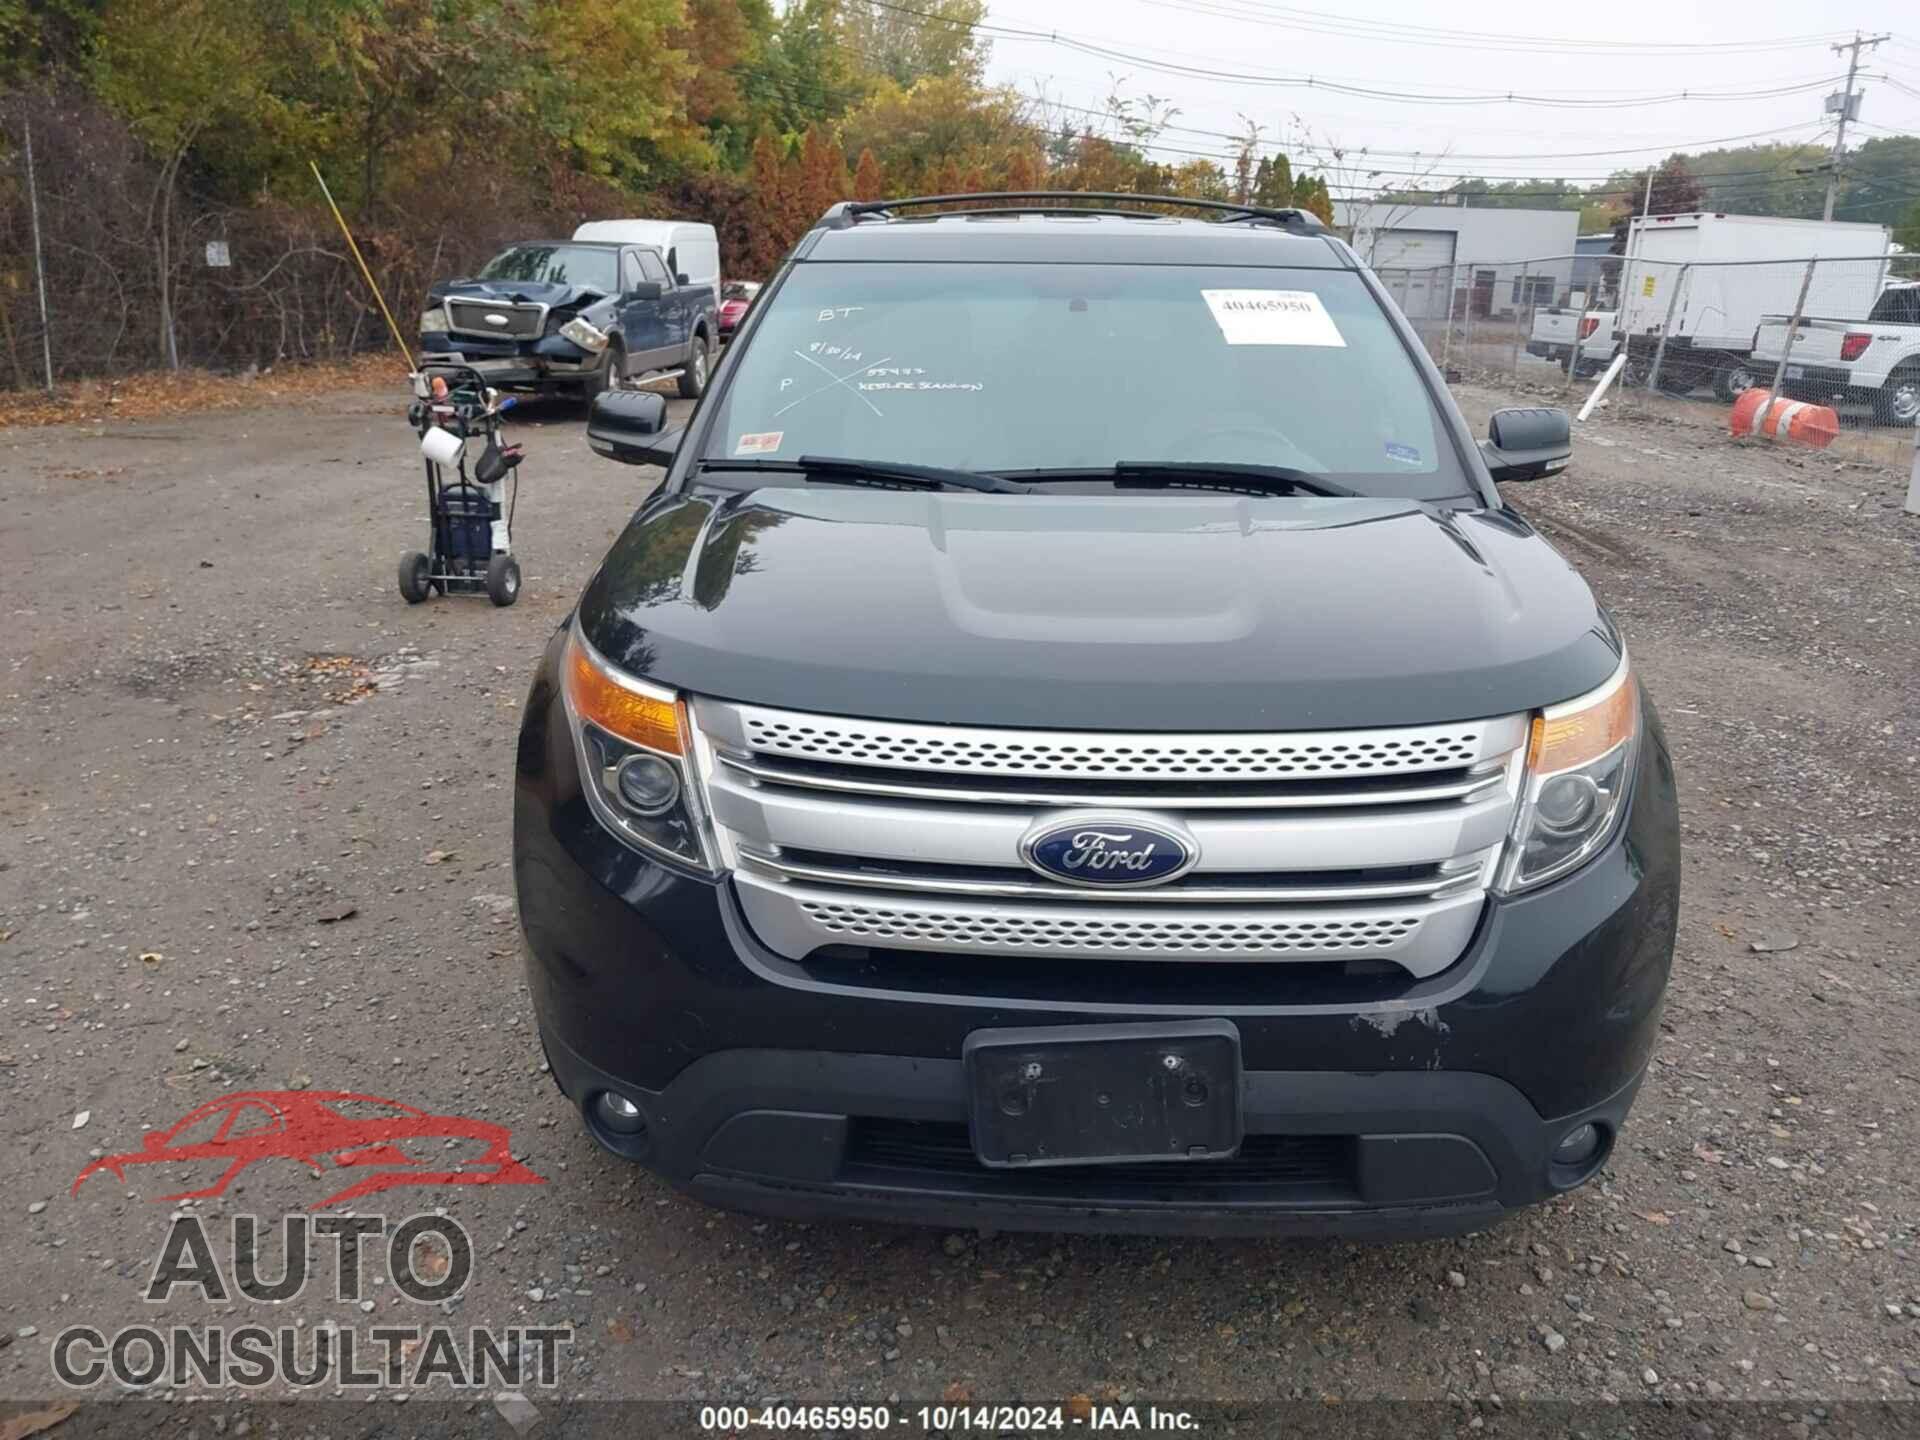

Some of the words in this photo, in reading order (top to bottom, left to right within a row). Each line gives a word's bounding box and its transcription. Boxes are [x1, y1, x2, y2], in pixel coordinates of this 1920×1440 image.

[1222, 300, 1313, 313] 40465950
[780, 378, 793, 391] P
[1062, 831, 1154, 871] Ford
